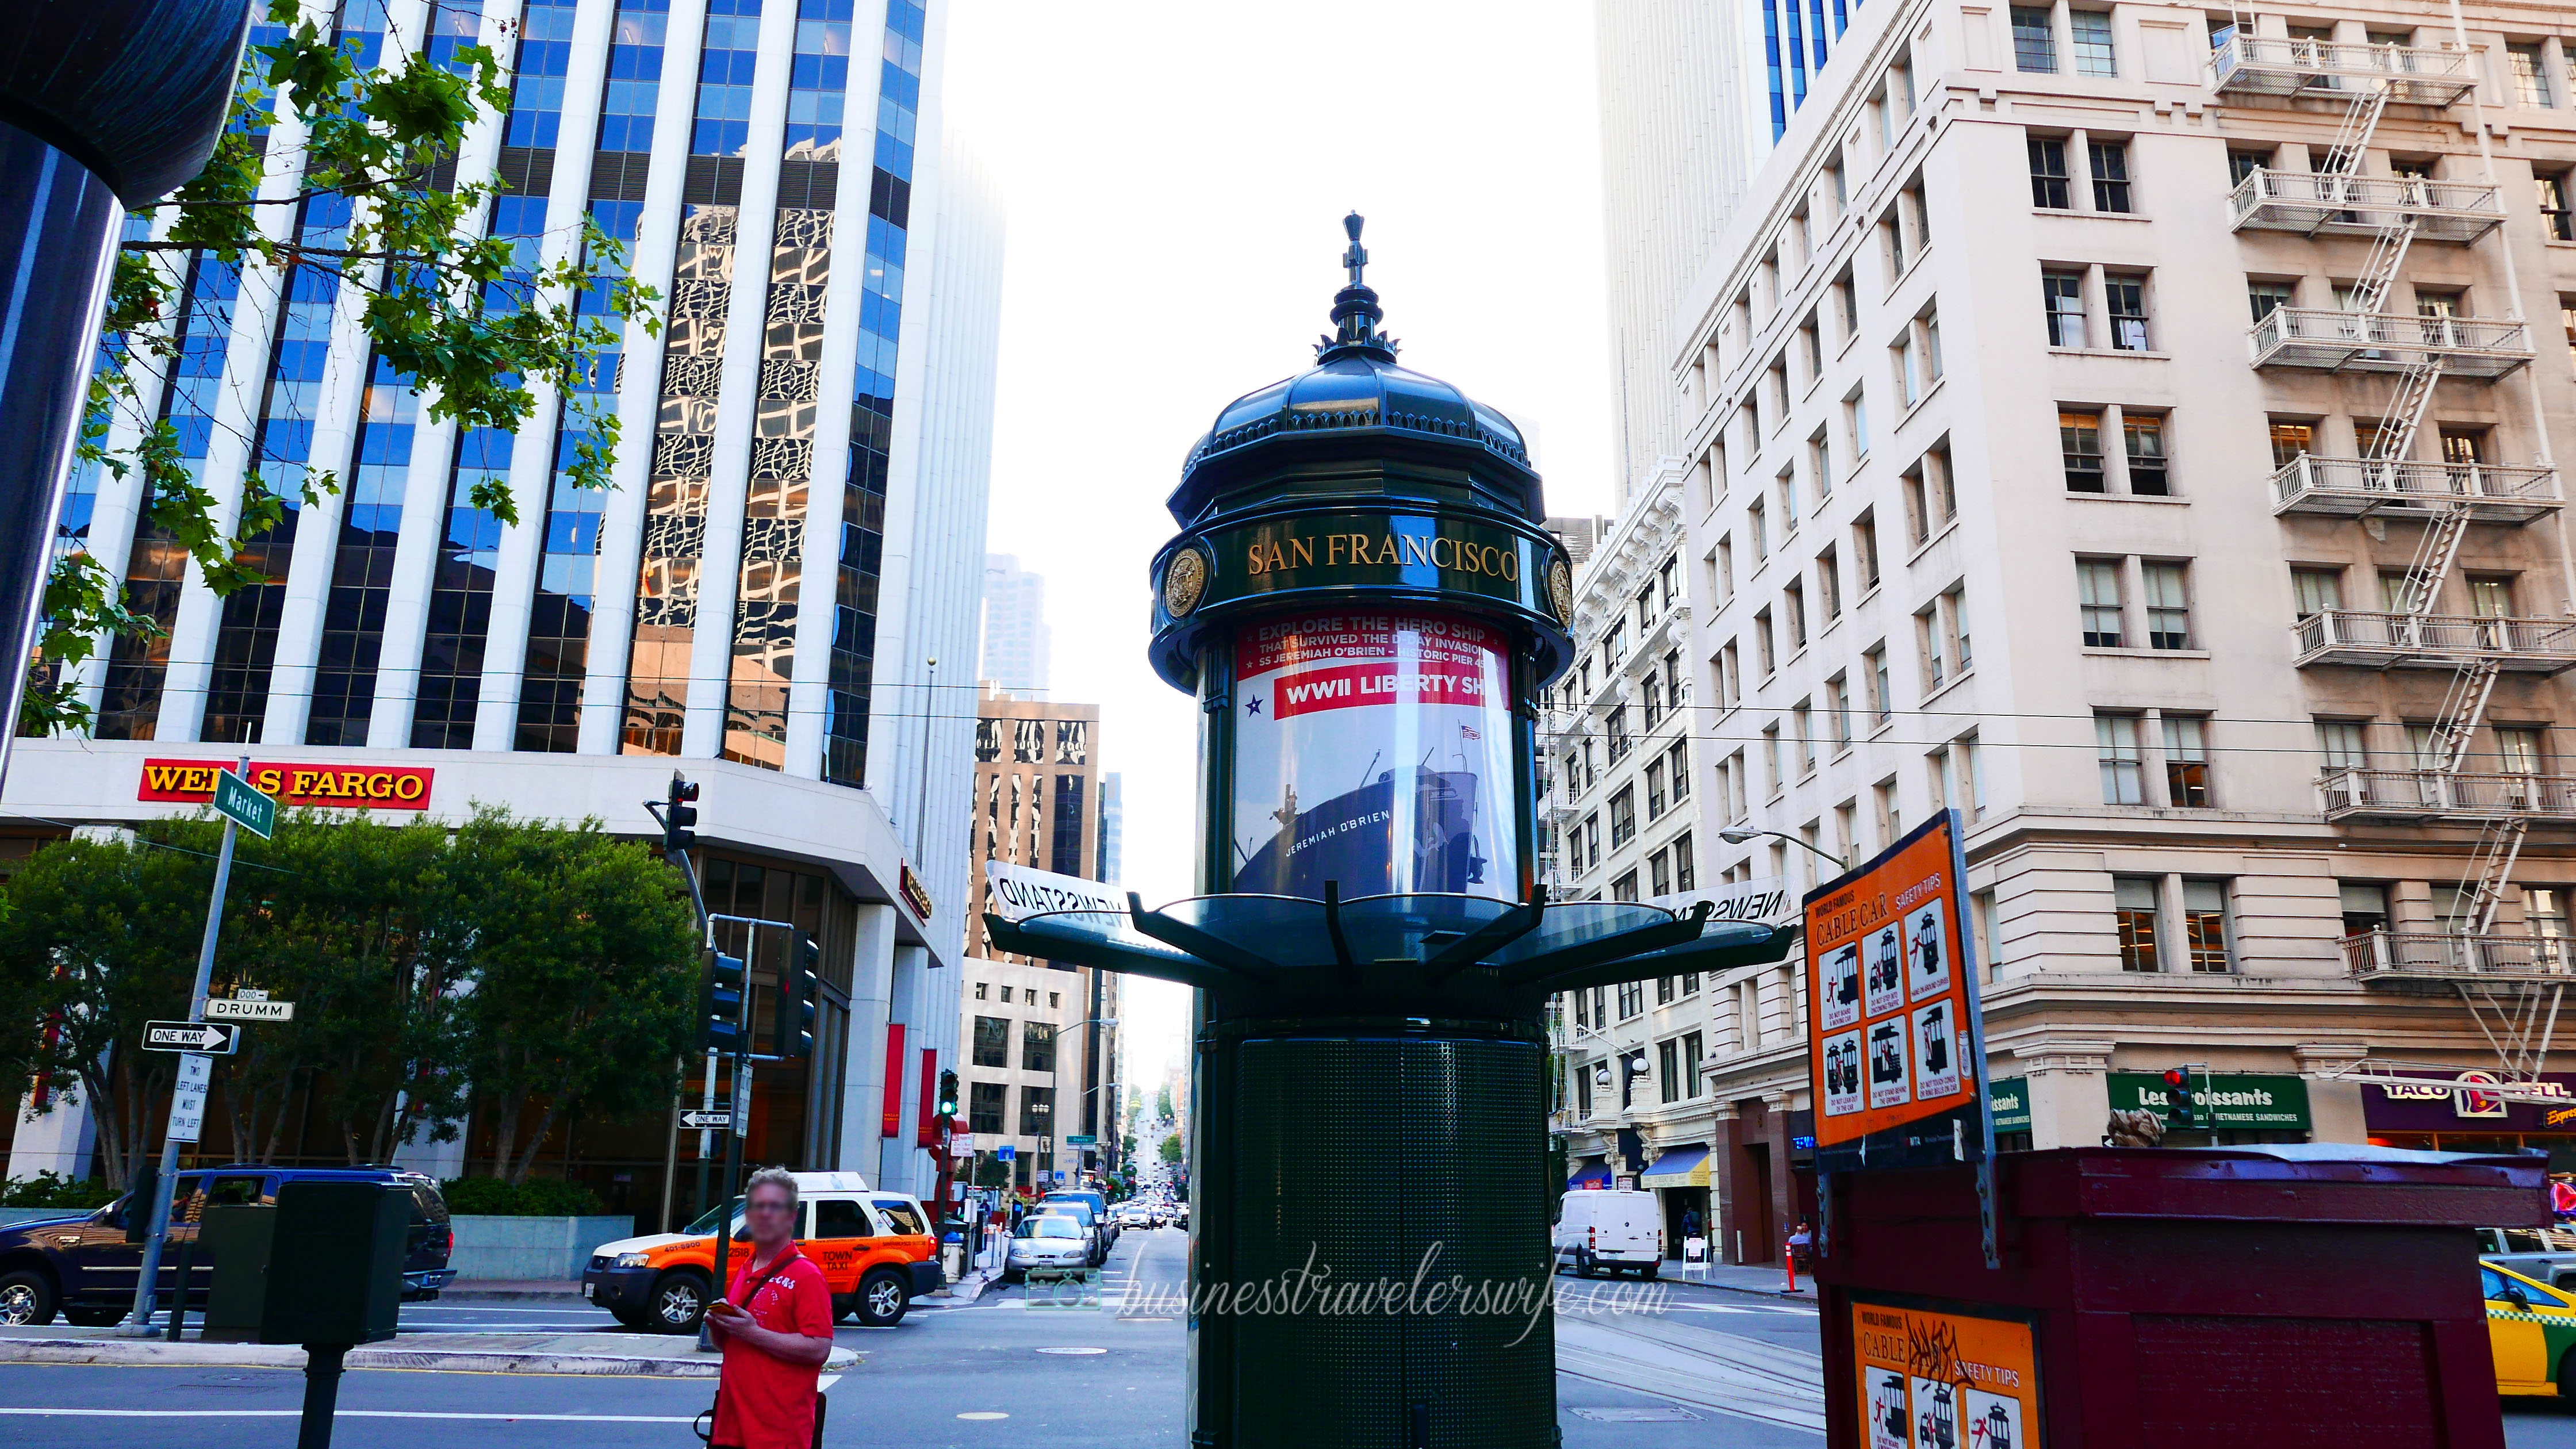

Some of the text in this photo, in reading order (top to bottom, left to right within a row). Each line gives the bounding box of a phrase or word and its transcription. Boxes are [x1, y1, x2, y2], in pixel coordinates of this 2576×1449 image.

[1249, 534, 1519, 581] SAN FRANCISCO
[1259, 616, 1485, 642] EXPLORE THE HERO SHIP
[1259, 634, 1484, 655] THAT SURVIVED THE D-DAY INVASION
[1259, 657, 1271, 667] SS
[1274, 647, 1332, 664] JEREMIAH
[1337, 646, 1385, 657] O'BRIEN
[1398, 648, 1450, 661] HISTORIC
[1452, 654, 1473, 666] PIER
[1286, 674, 1485, 704] WWII LIBERTY SH
[144, 766, 424, 800] WELS FARGO
[229, 786, 262, 823] Market
[1286, 810, 1390, 857] JEREMIAH O'BRIEN
[1896, 872, 1941, 910] SAFETY TIPS
[1815, 890, 1854, 919] WORLD FAMOUS
[1816, 893, 1888, 946] CABLE CAR
[217, 1003, 283, 1016] DRUMM
[154, 1030, 206, 1043] ONE WAY
[190, 1065, 201, 1077] TWO
[175, 1080, 208, 1094] LEFT LANES
[2138, 1086, 2273, 1106] Les oissants
[2386, 1083, 2450, 1098] TACO
[182, 1099, 196, 1111] MUST
[1990, 1092, 2019, 1111] issants
[172, 1116, 200, 1128] TURN LEFT
[2256, 1113, 2298, 1122] SANDWICHES
[729, 1247, 750, 1258] 2518
[823, 1251, 853, 1261] TOWN
[826, 1261, 848, 1271] TAXI
[1862, 1311, 1903, 1330] WORLD FAMOUS
[1863, 1331, 1906, 1363] CABLE
[1955, 1359, 2019, 1389] SAFETY TIPS
